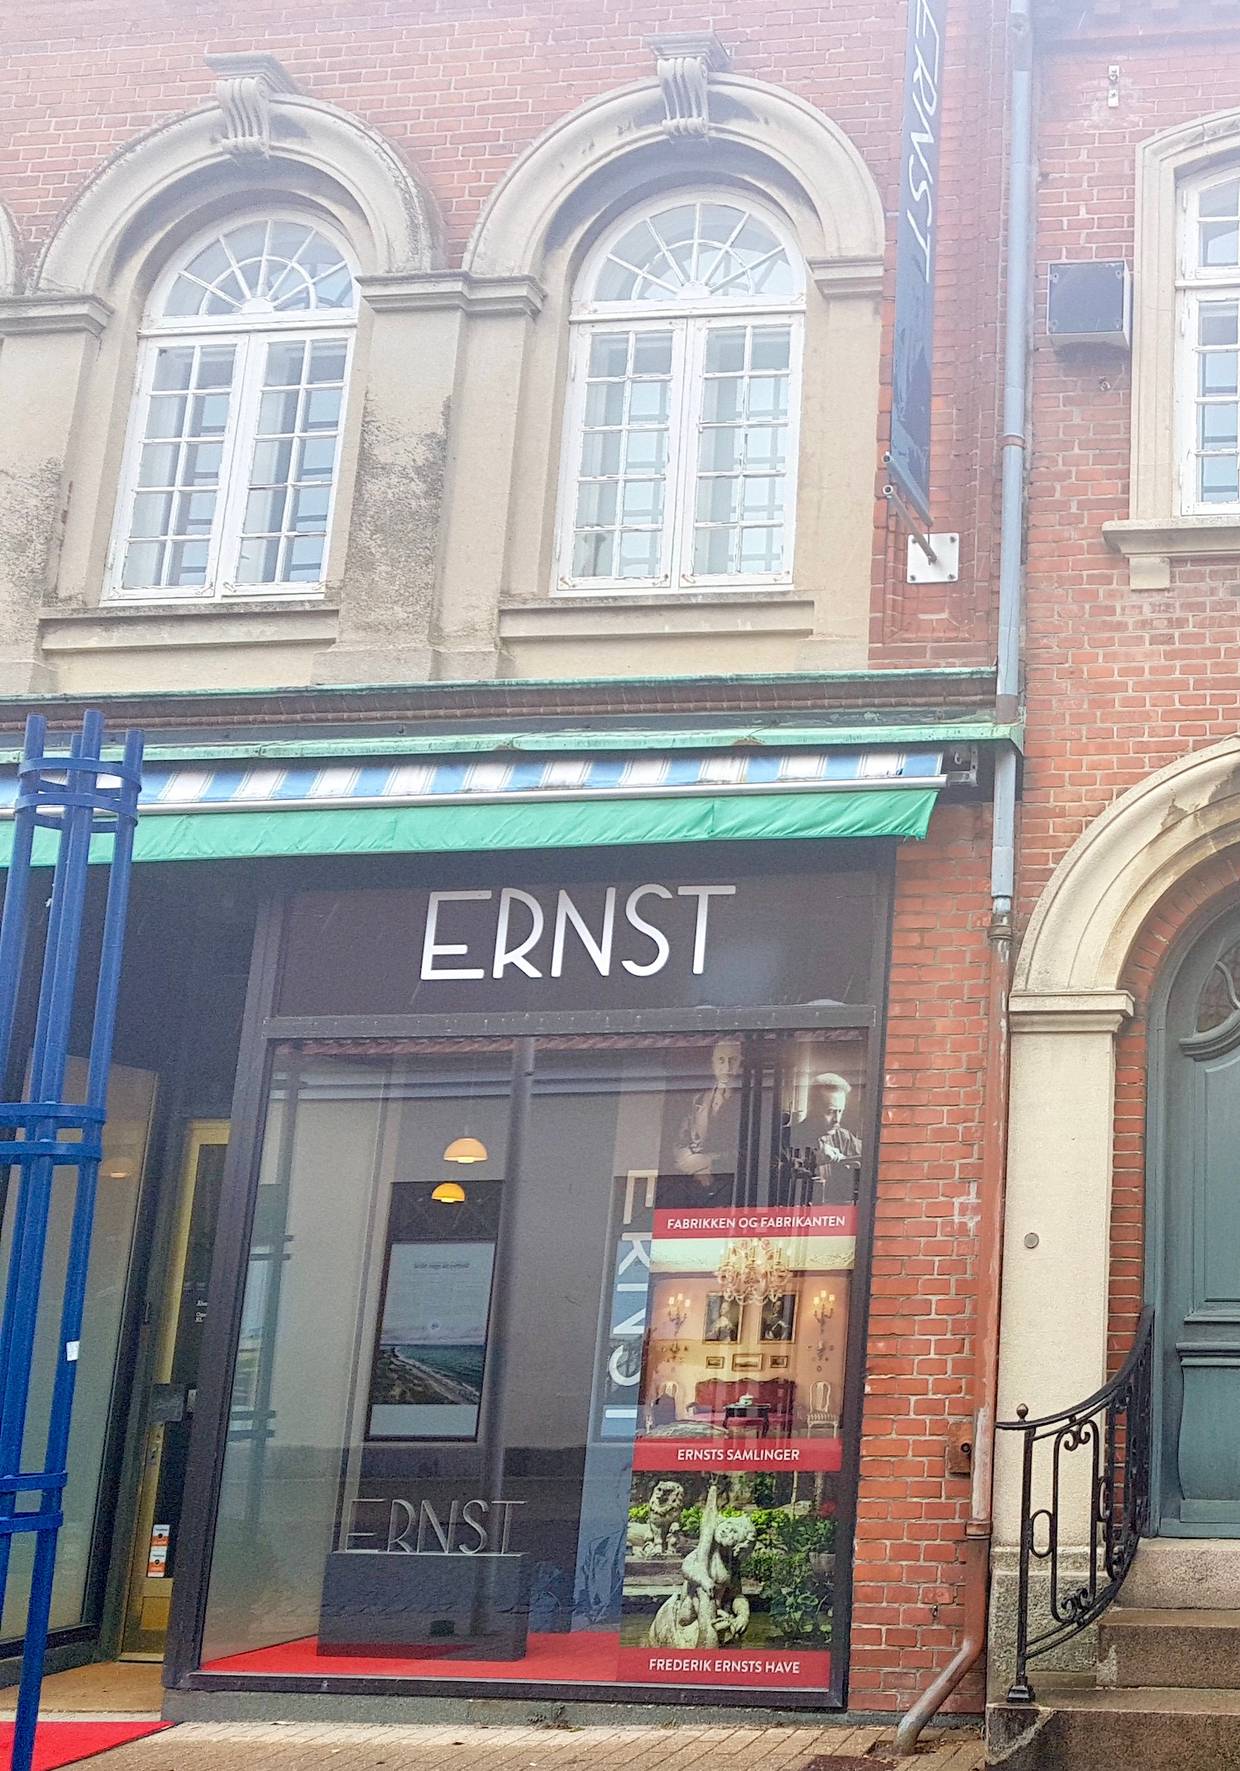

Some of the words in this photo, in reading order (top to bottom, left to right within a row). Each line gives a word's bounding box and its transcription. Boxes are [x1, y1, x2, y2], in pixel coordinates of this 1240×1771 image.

[420, 883, 737, 981] ERNST
[667, 1217, 736, 1230] FABRIKKEN
[738, 1216, 758, 1228] OG
[760, 1215, 846, 1228] FABRIKANTEN
[677, 1448, 724, 1461] ERNSTS
[726, 1448, 800, 1461] SAMLINGER
[339, 1498, 528, 1554] ERNST
[649, 1658, 712, 1672] FREDERIK
[714, 1659, 763, 1673] ERNSTS
[765, 1660, 801, 1674] HAVE
